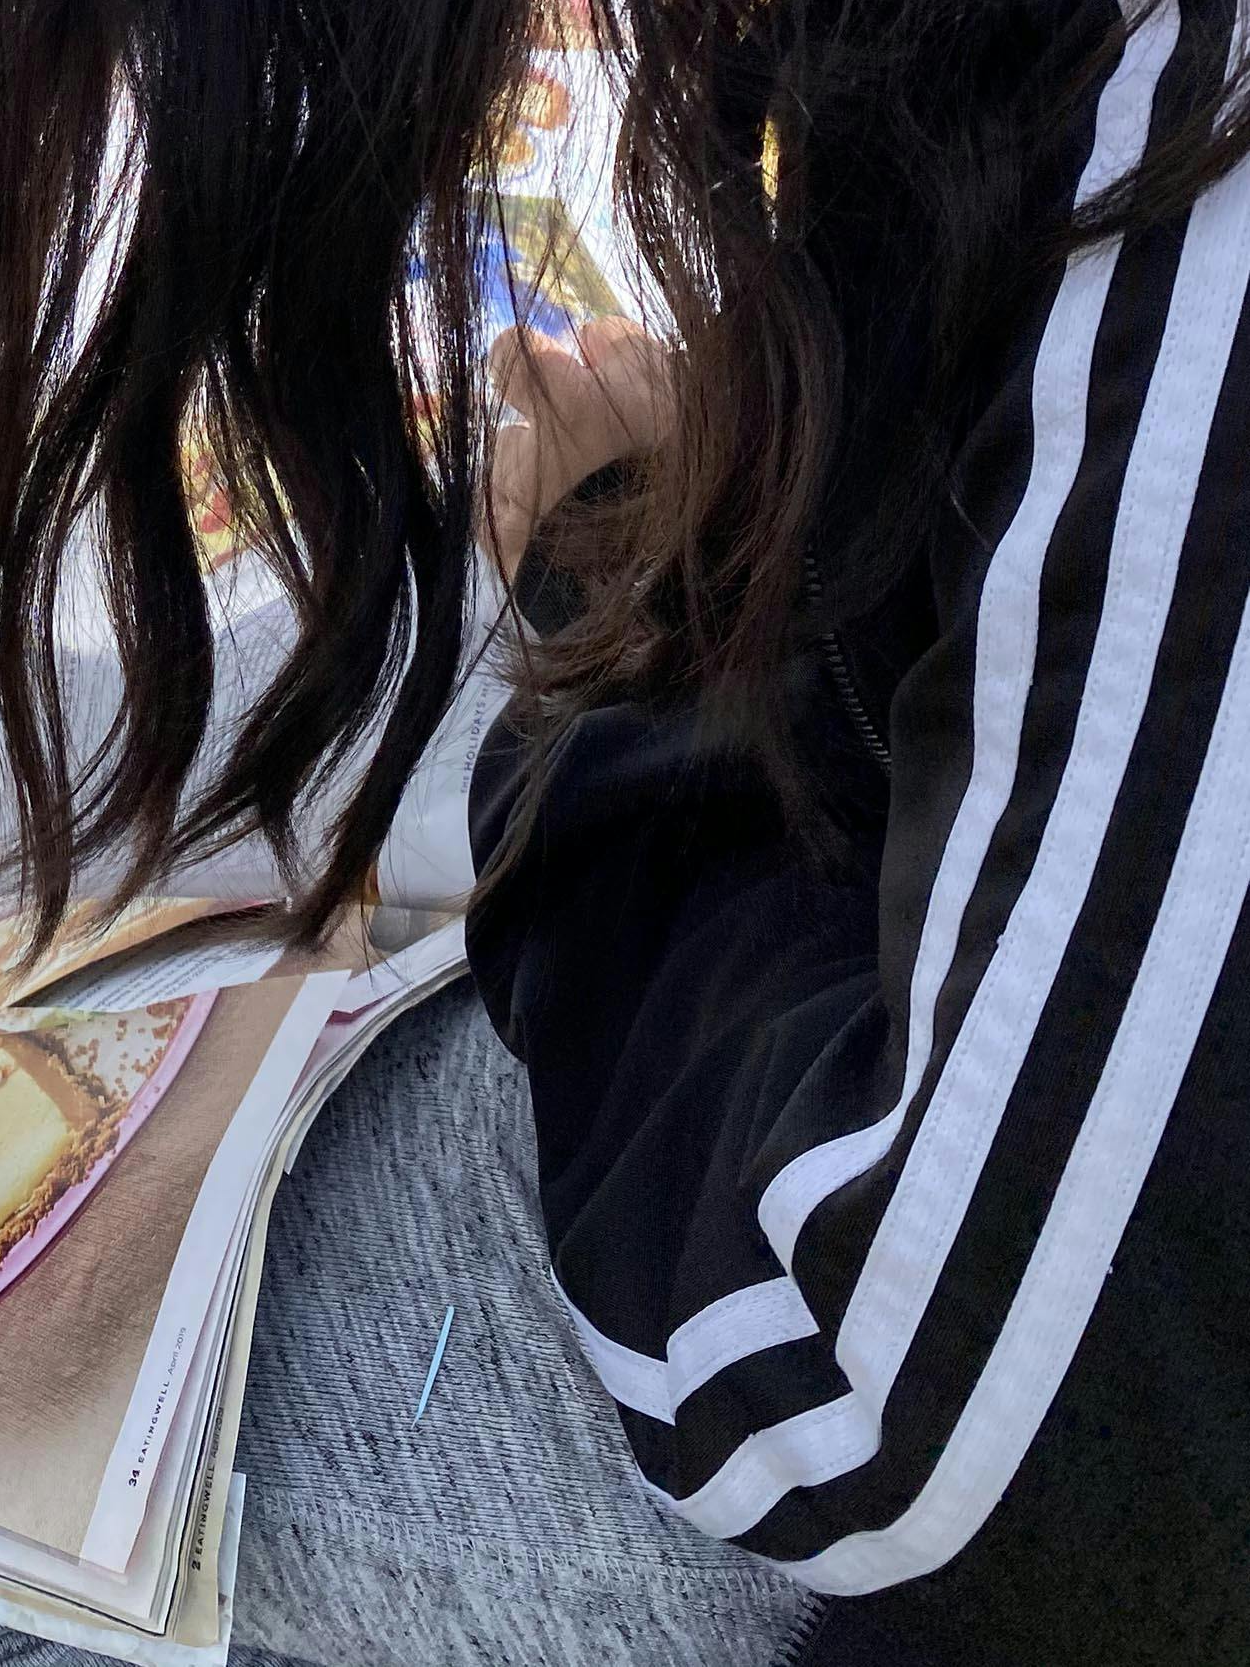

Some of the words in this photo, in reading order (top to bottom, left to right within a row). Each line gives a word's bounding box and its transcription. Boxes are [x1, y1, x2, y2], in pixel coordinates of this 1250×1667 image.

[129, 1469, 140, 1487] 34
[138, 1381, 170, 1463] EATINGWELL
[167, 1351, 178, 1375] April
[175, 1327, 186, 1350] 2019
[191, 1561, 200, 1572] 2
[196, 1464, 215, 1555] EATINGWELL
